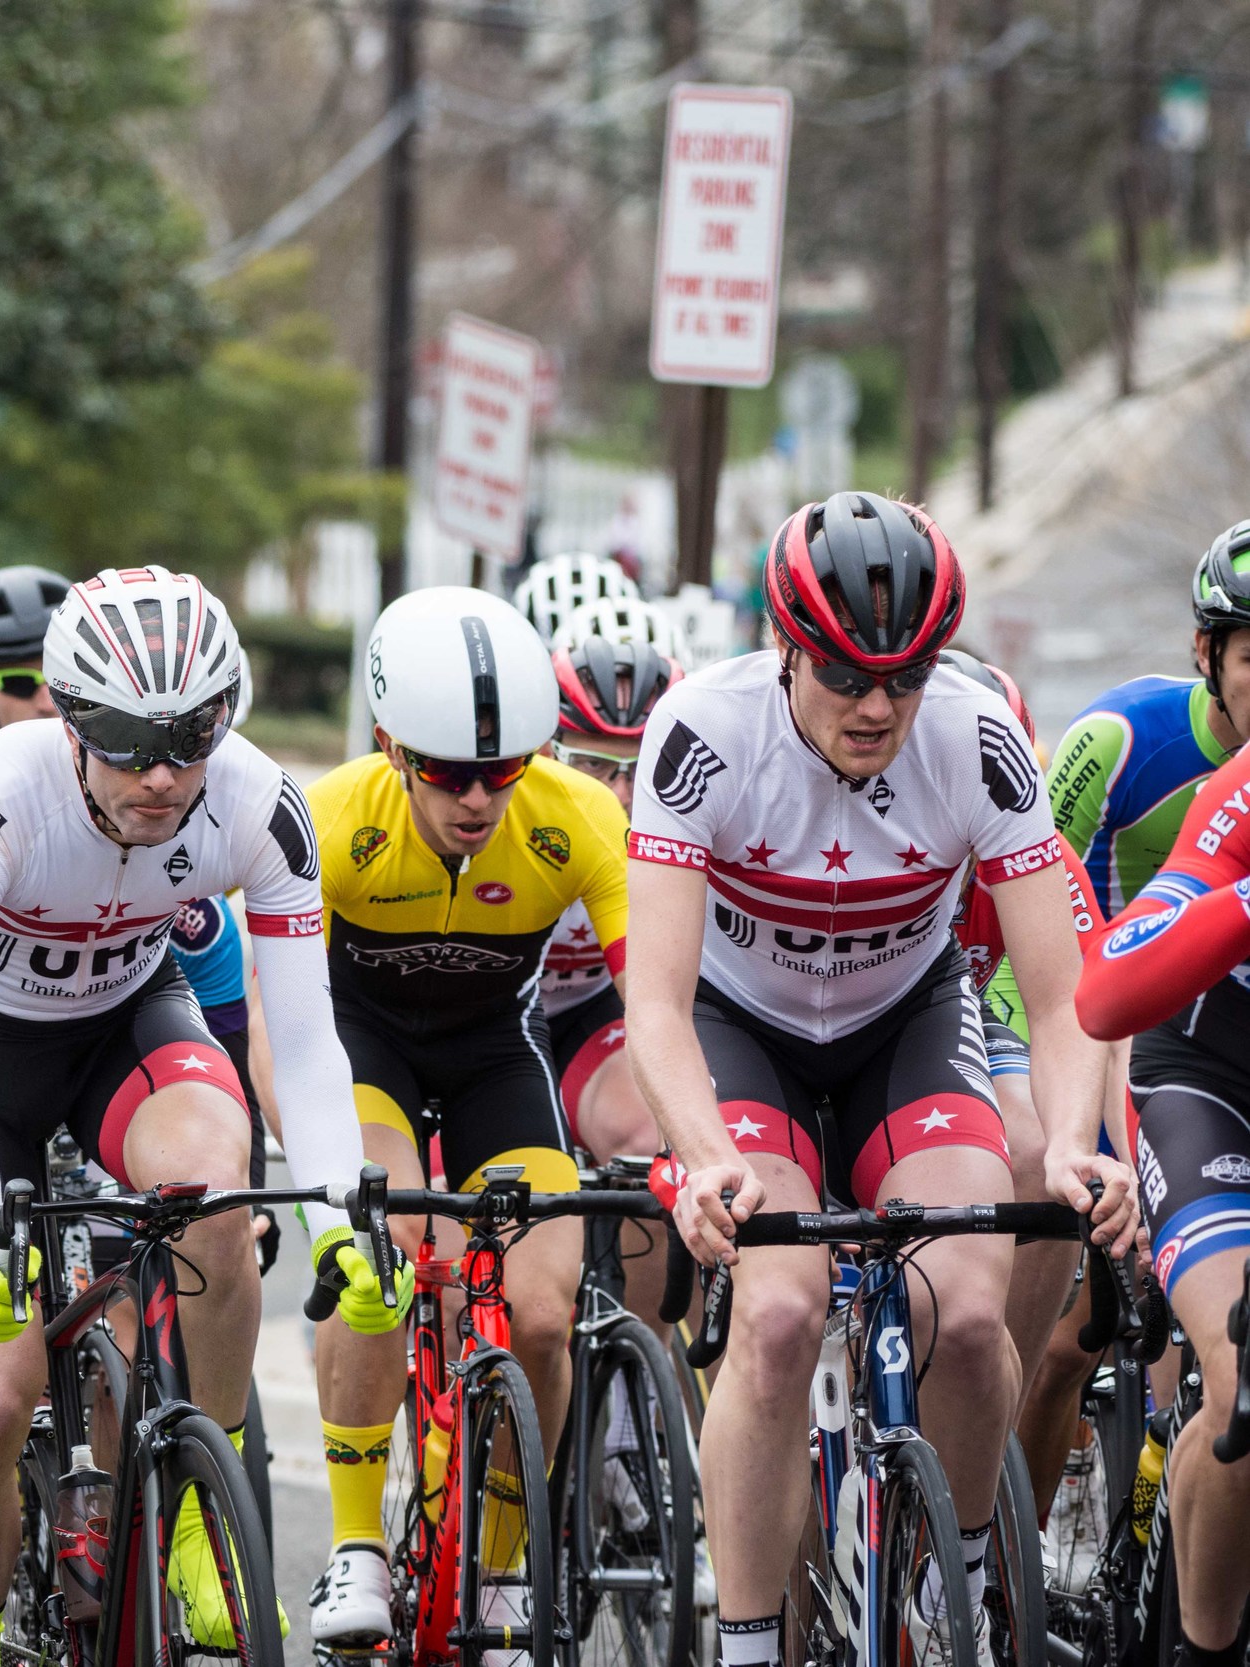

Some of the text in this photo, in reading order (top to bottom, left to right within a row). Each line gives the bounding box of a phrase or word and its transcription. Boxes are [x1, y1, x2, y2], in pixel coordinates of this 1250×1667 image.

[777, 564, 796, 604] GIRO
[228, 661, 240, 681] CAS
[476, 642, 488, 673] OCTAL
[1049, 732, 1094, 801] mpion
[1195, 781, 1250, 857] BEY
[638, 836, 706, 867] NCVC
[1002, 838, 1062, 877] NCVC
[287, 911, 324, 936] NC
[1065, 870, 1095, 933] UTO
[29, 908, 180, 979] UHC
[774, 904, 940, 954] UHC
[20, 928, 172, 998] UnitedHealthcar
[887, 1208, 924, 1218] QUARQ
[17, 1232, 27, 1292] ULTEGRA
[376, 1219, 392, 1277] ULTEGRA
[706, 1257, 730, 1333] RAM
